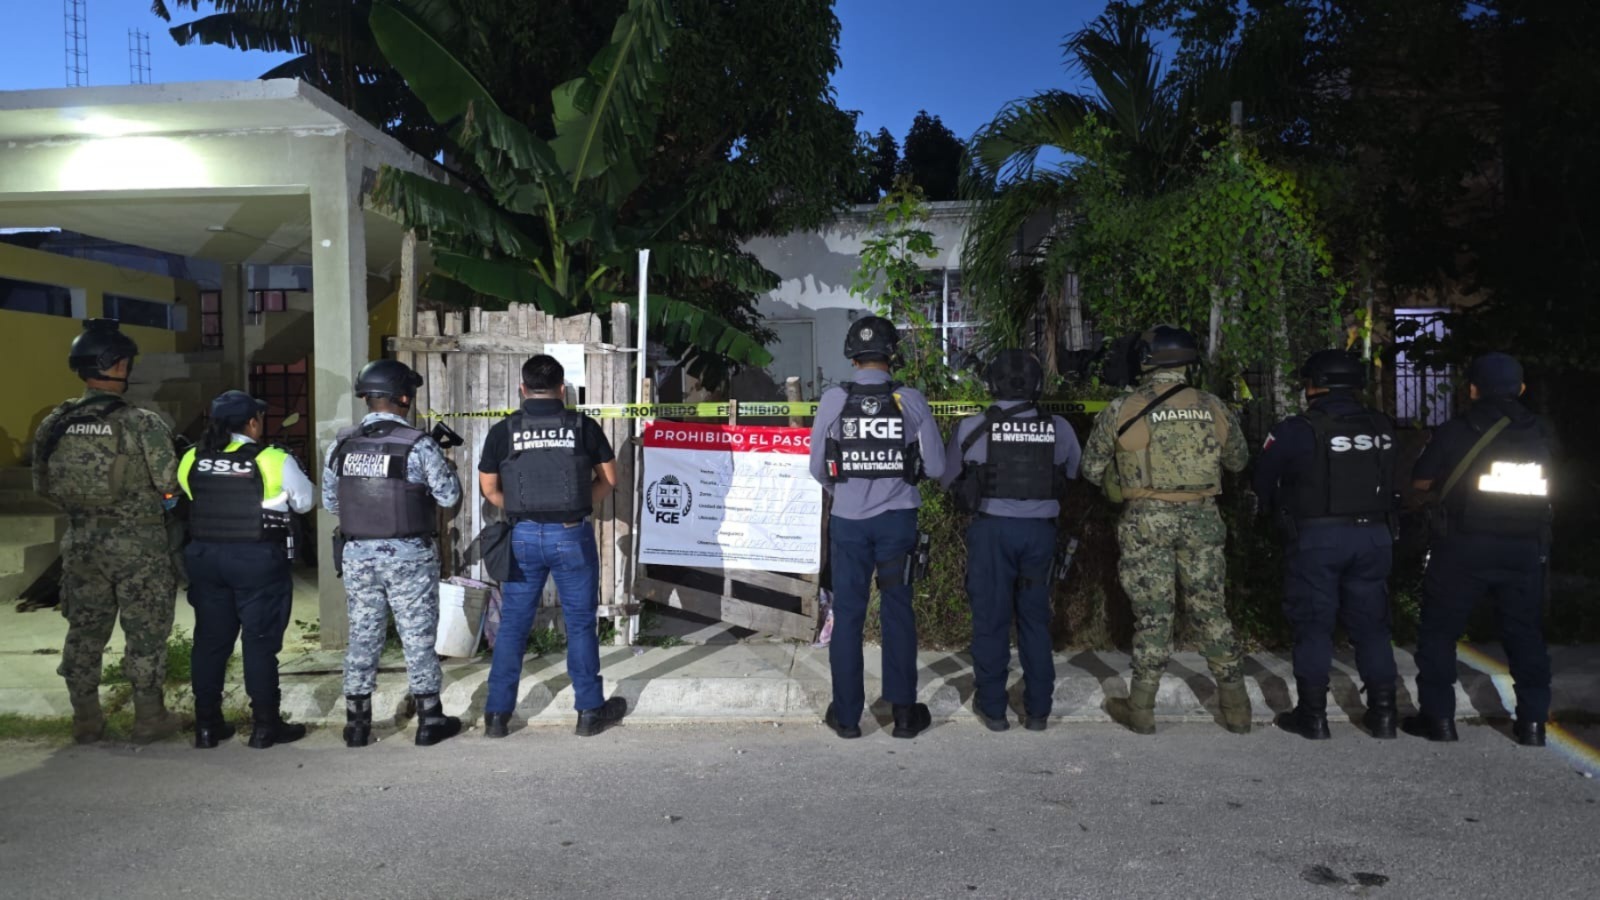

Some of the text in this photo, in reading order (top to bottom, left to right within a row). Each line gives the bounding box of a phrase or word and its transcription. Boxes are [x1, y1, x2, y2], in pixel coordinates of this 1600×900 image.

[621, 406, 697, 417] PROHIBIDO
[928, 404, 984, 415] OHIBIDO
[1151, 409, 1213, 423] MARINA
[65, 424, 113, 436] ARINA
[859, 417, 903, 439] FGE
[991, 420, 1056, 433] POLICÍA
[513, 428, 575, 442] POLICÍA
[654, 429, 744, 445] PROHIBIDO
[748, 436, 769, 445] EL
[991, 432, 1056, 443] DE INVESTIGACIÓN
[513, 438, 575, 451] DE INVESTIGACIÓN
[1331, 434, 1392, 453] SSC
[347, 454, 385, 465] GUARDIA
[842, 449, 903, 461] POLICÍA
[197, 458, 253, 474] SSC
[344, 463, 386, 477] NACIONAL
[842, 459, 904, 471] DE INVESTIGACIÓN
[656, 510, 680, 525] FGE
